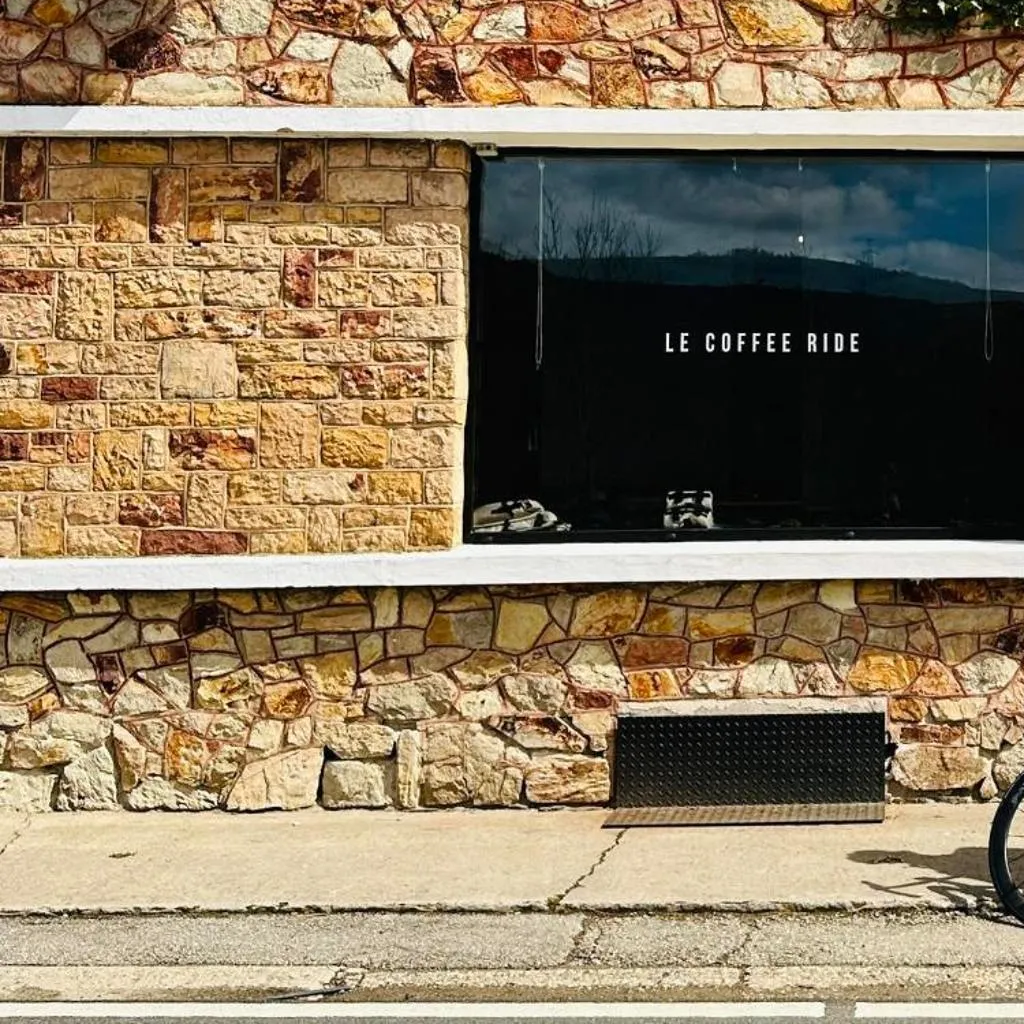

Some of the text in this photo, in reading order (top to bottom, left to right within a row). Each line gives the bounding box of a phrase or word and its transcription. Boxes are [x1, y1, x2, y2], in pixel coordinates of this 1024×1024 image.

[665, 332, 860, 353] LE COFFEE RIDE
